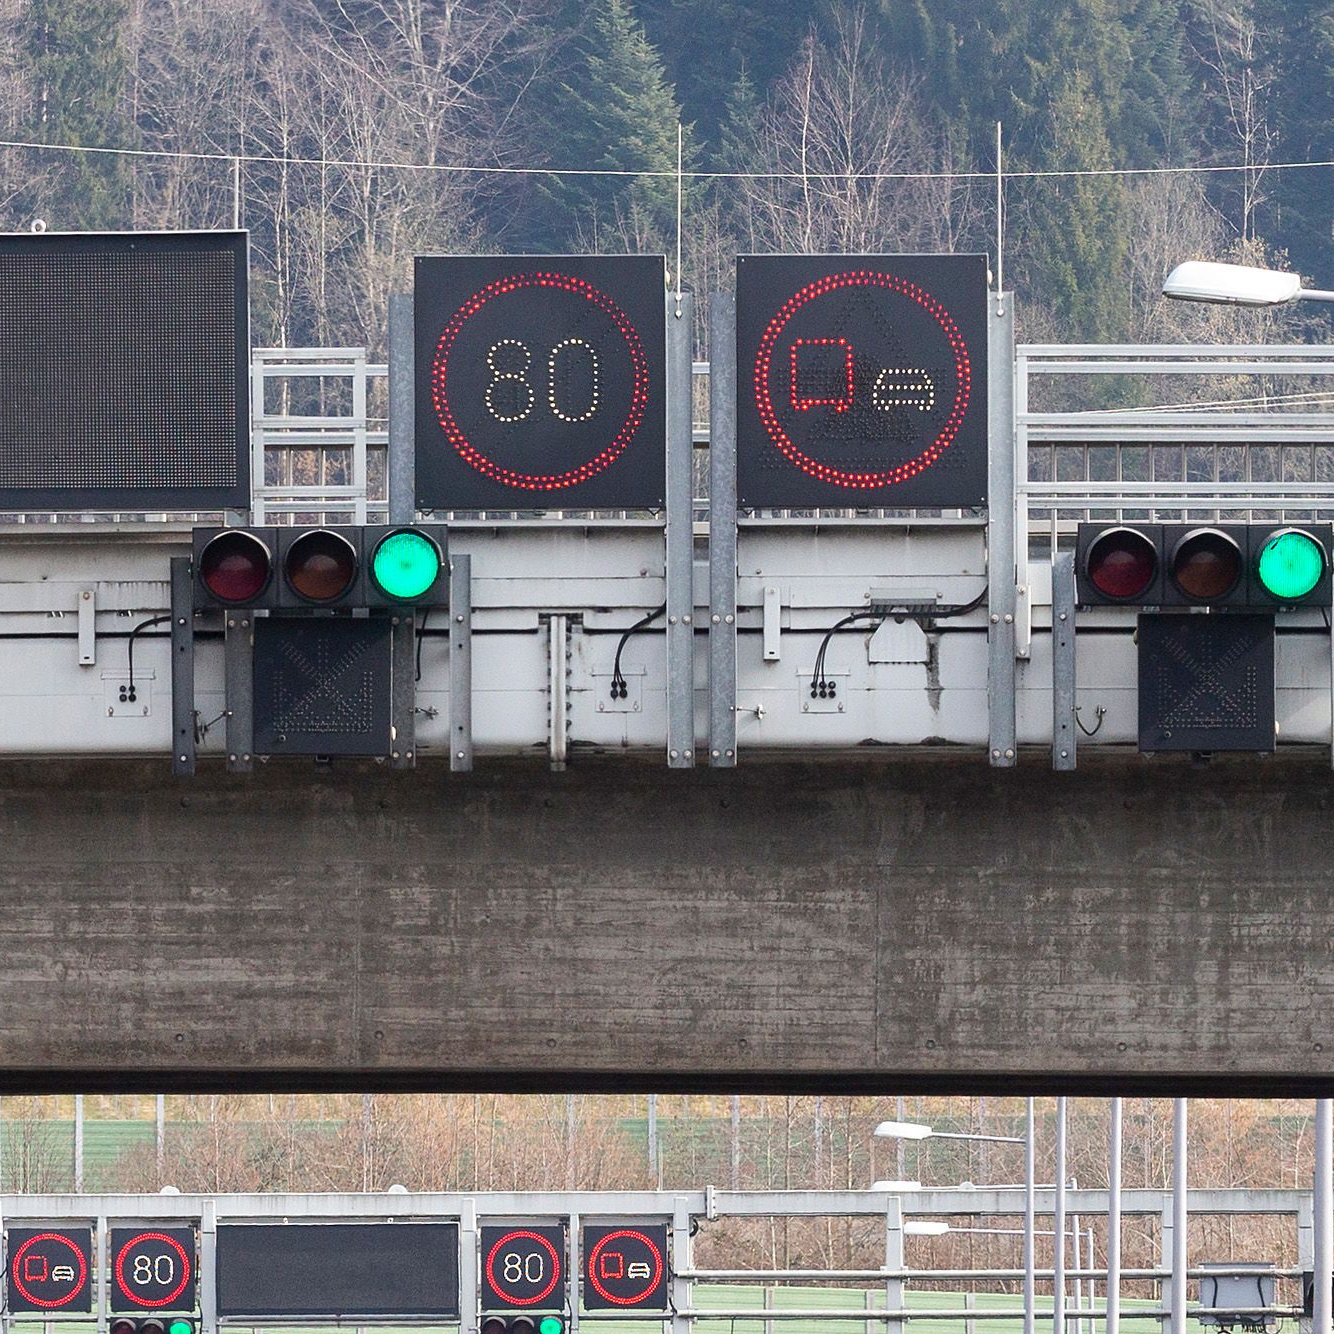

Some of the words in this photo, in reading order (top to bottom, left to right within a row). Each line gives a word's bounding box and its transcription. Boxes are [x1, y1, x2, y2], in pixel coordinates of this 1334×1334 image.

[486, 339, 598, 422] 80
[133, 1255, 174, 1285] 80
[504, 1252, 544, 1283] 80
